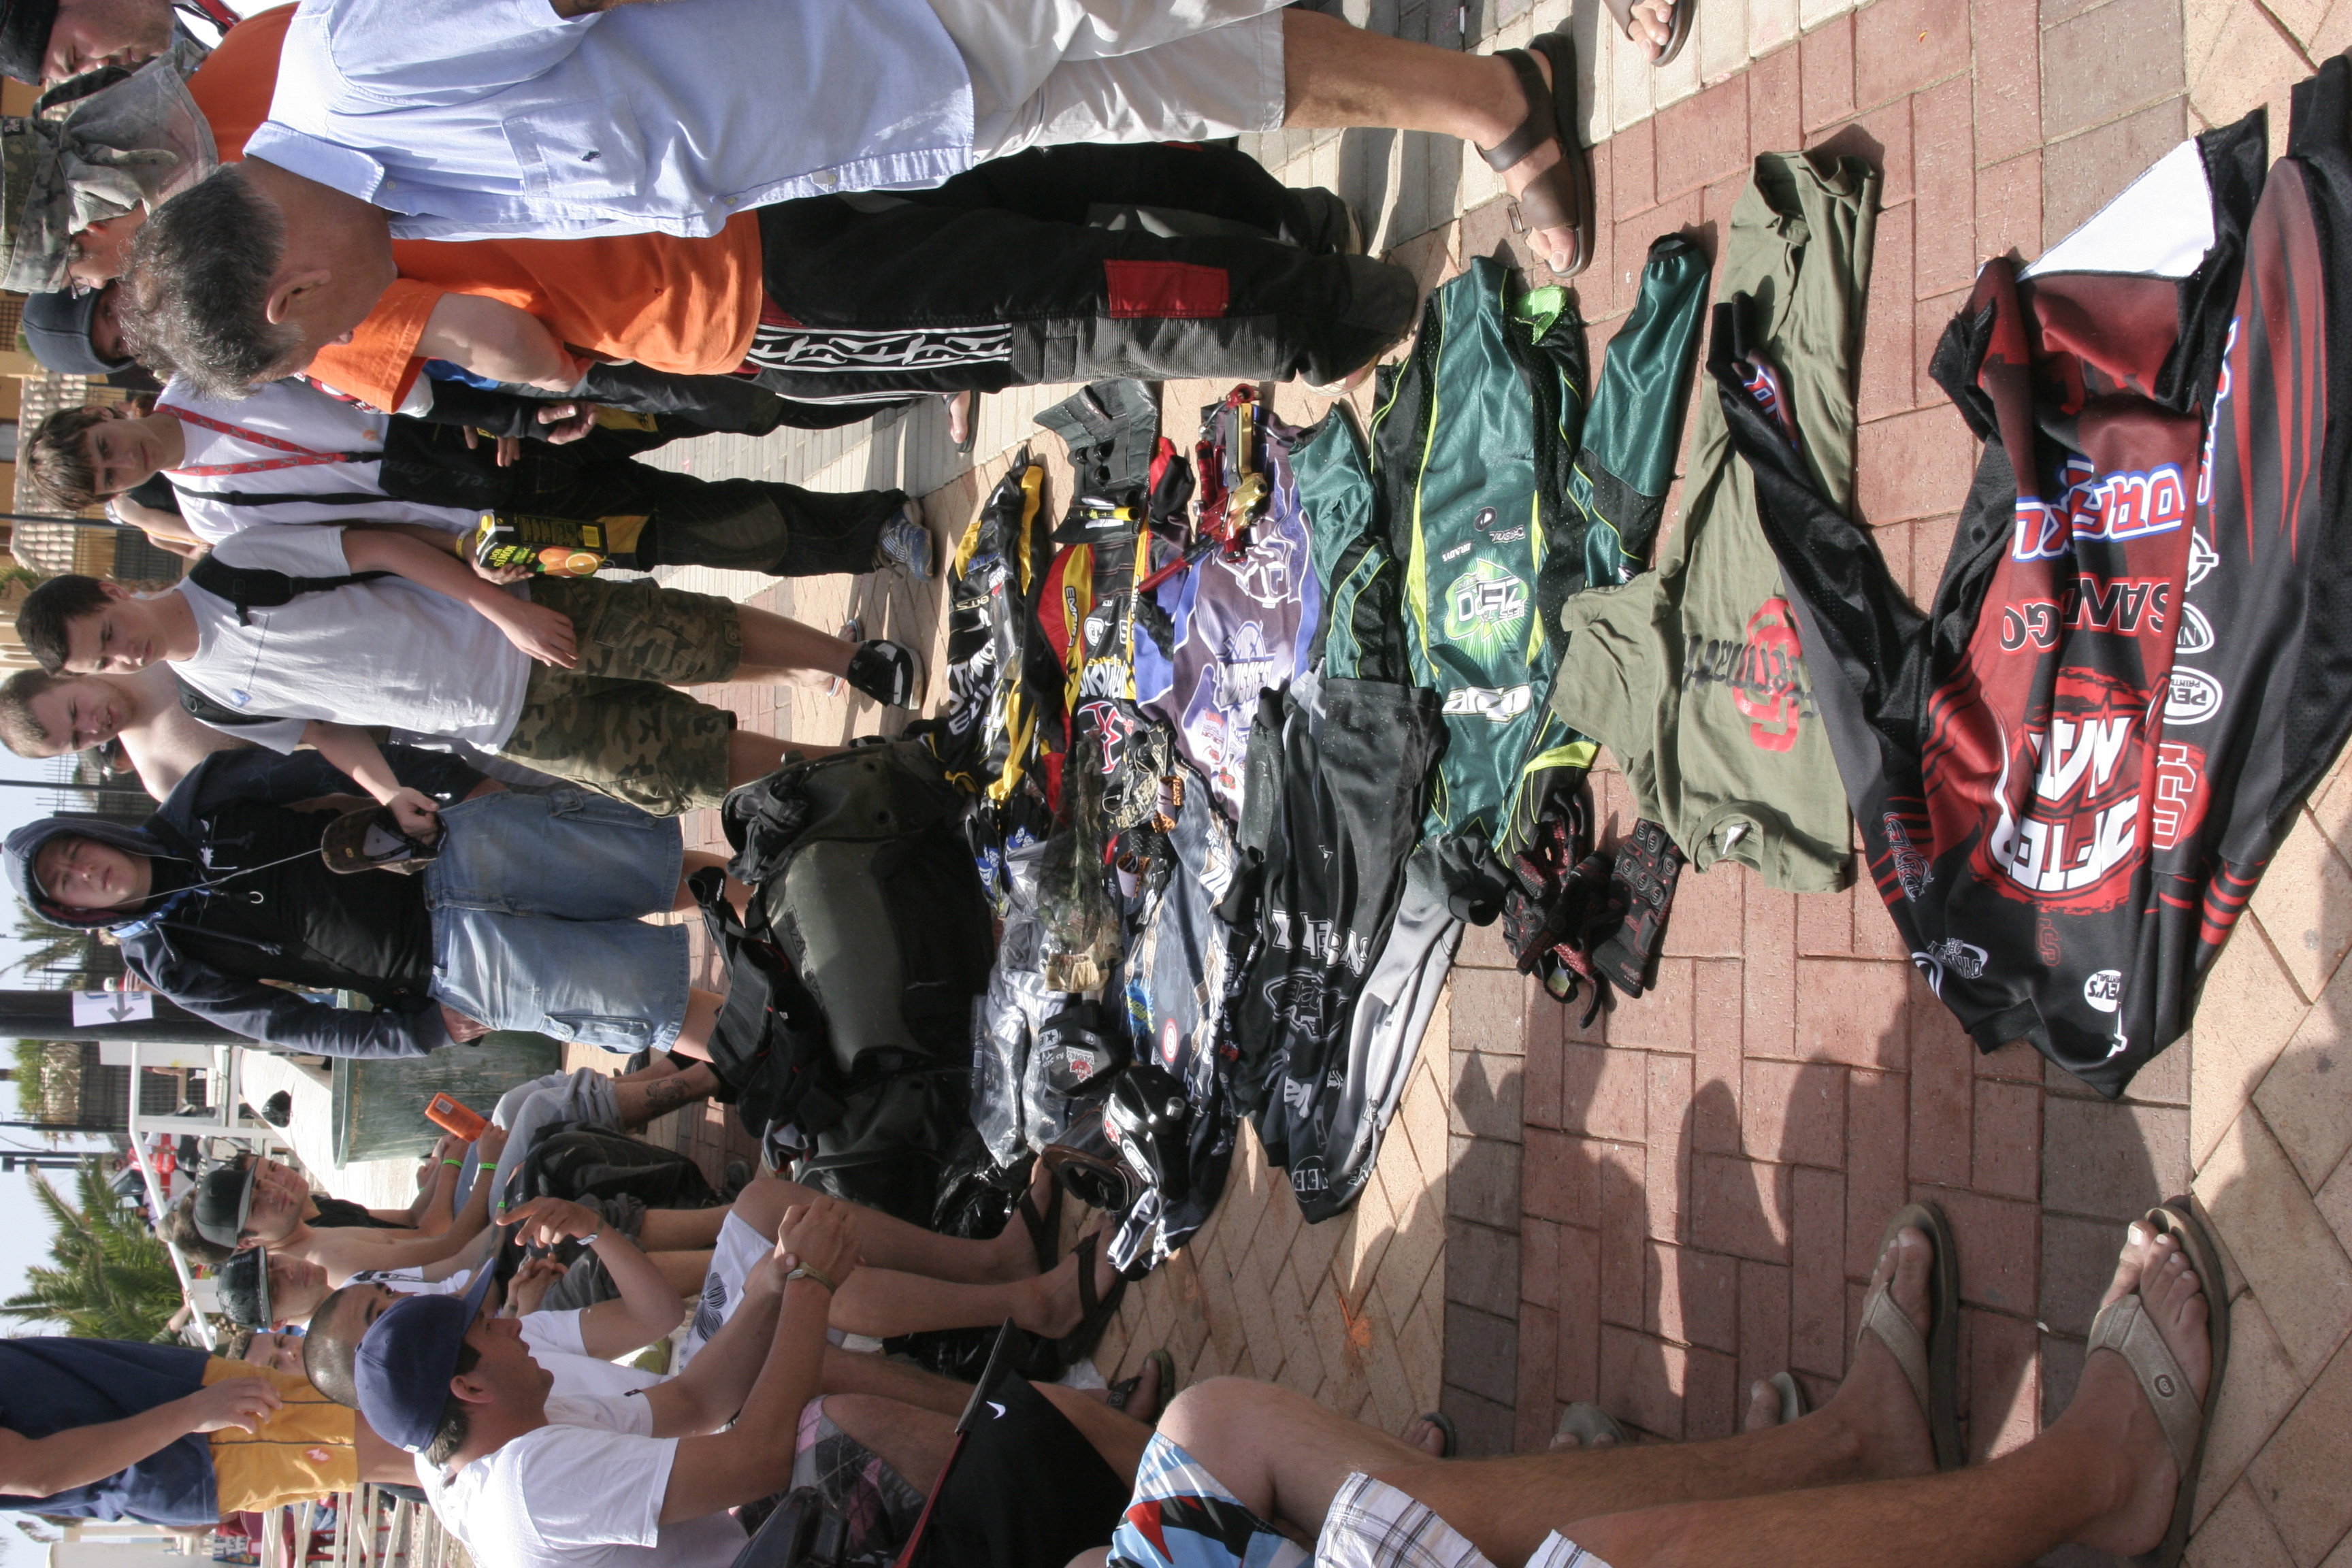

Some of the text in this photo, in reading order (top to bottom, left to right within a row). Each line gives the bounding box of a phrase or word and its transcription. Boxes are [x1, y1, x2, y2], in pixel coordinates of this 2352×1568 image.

[489, 548, 503, 561] DON
[493, 545, 518, 568] SIMON
[1989, 758, 2138, 892] AFTER
[2087, 980, 2120, 1000] EV'S
